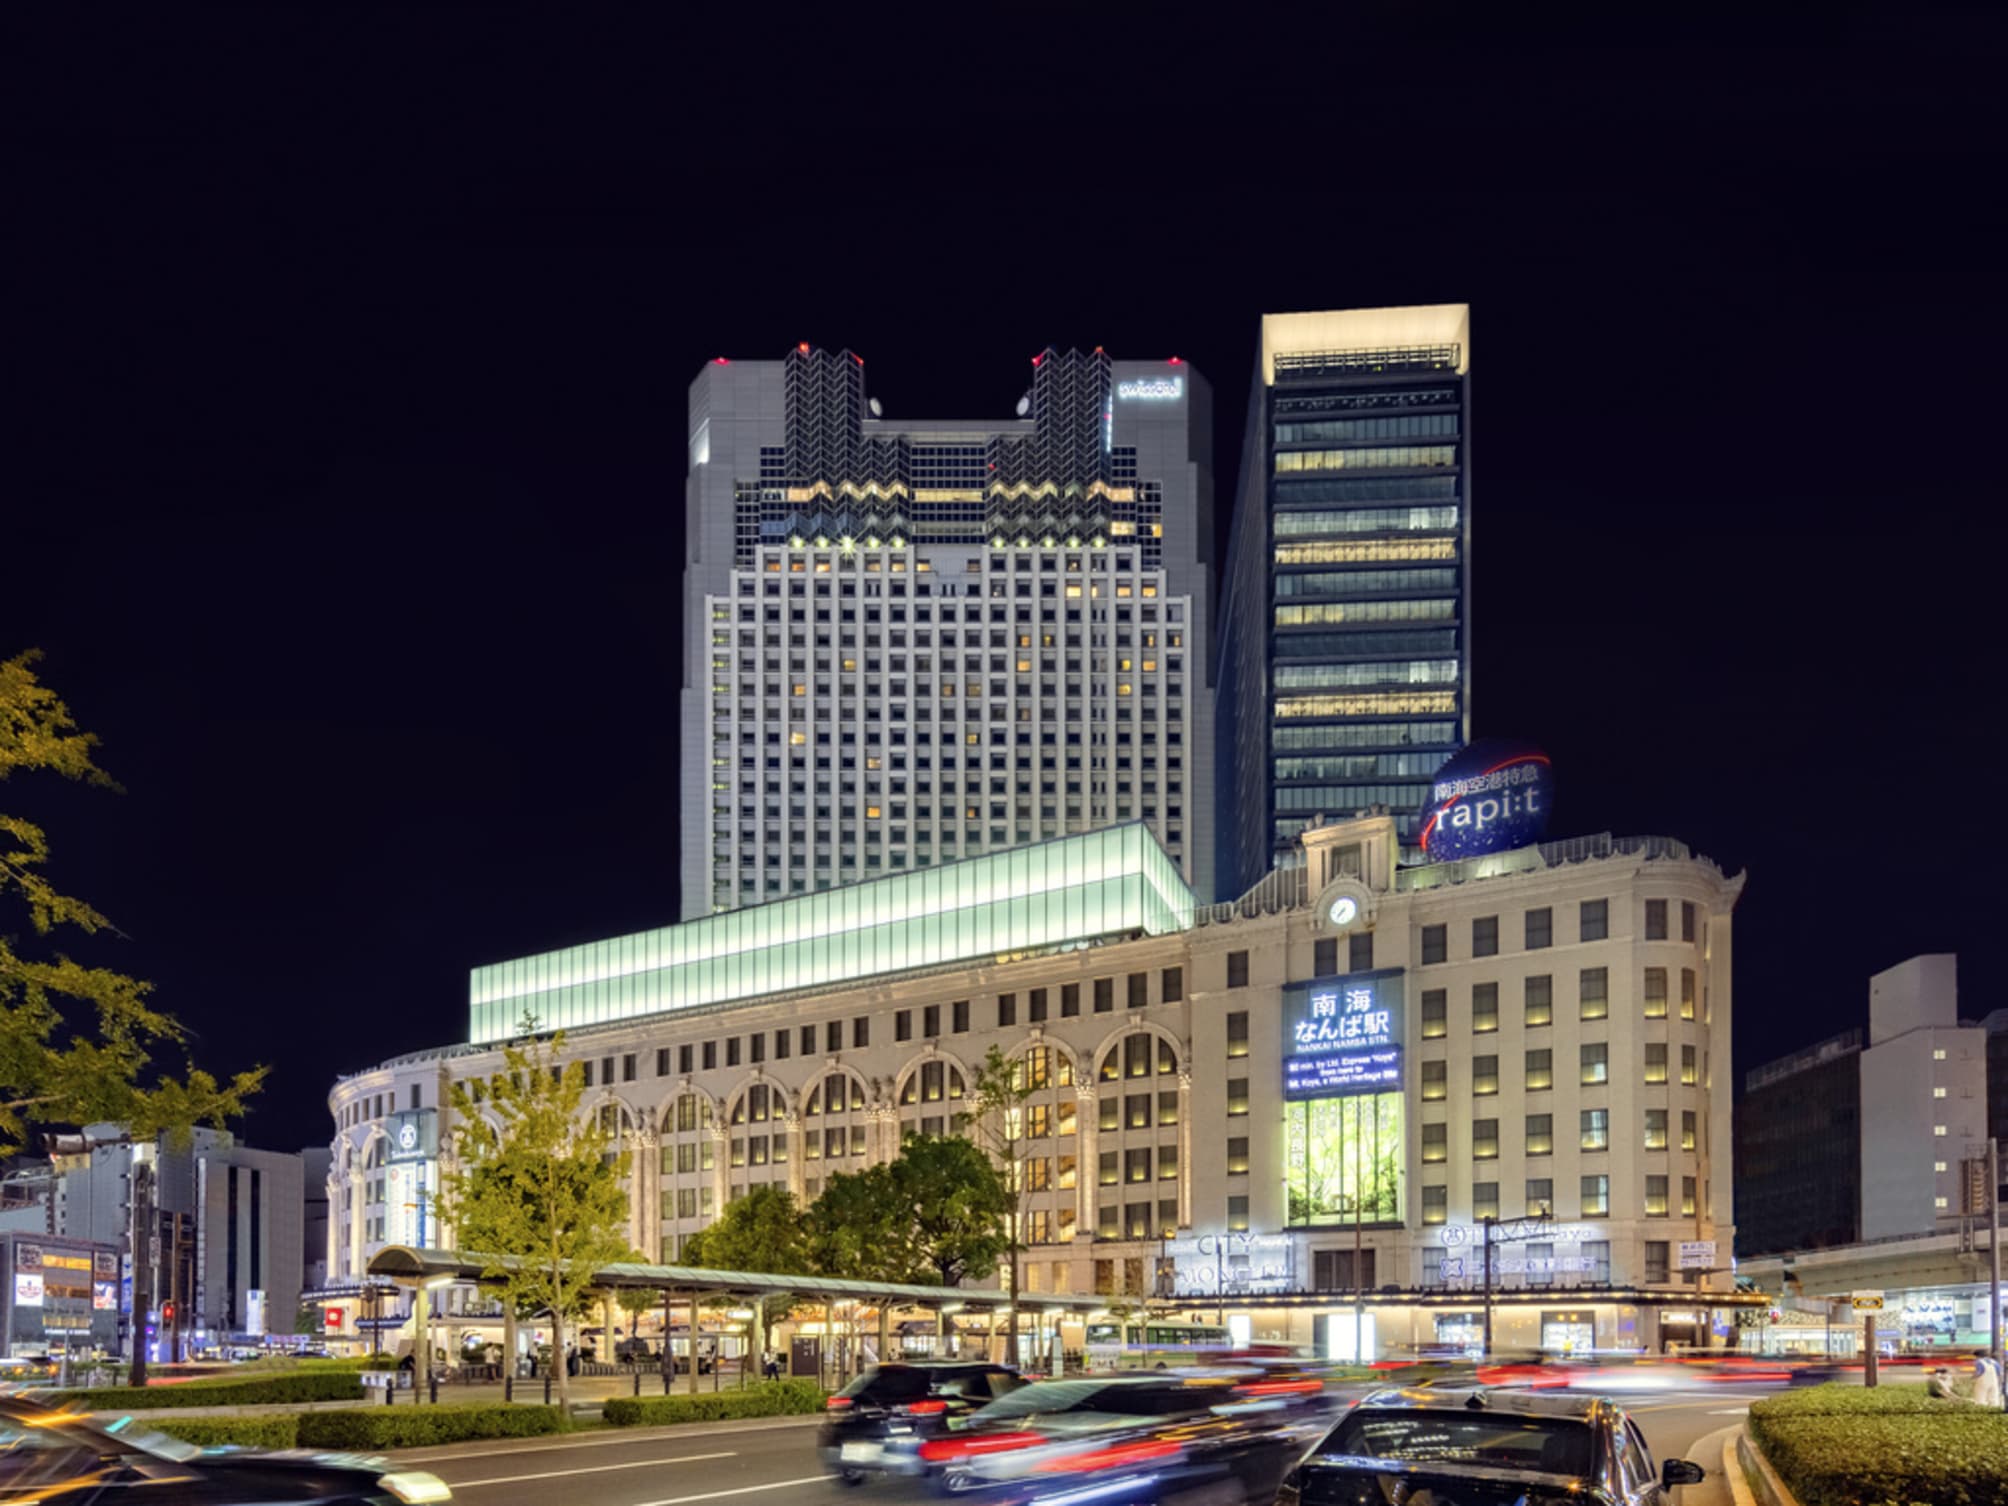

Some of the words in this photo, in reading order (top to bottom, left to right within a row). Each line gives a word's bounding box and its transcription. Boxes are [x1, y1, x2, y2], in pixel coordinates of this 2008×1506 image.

[1435, 787, 1540, 832] rapi:t
[1295, 1011, 1389, 1042] なんば駅
[1198, 1233, 1256, 1256] CITY
